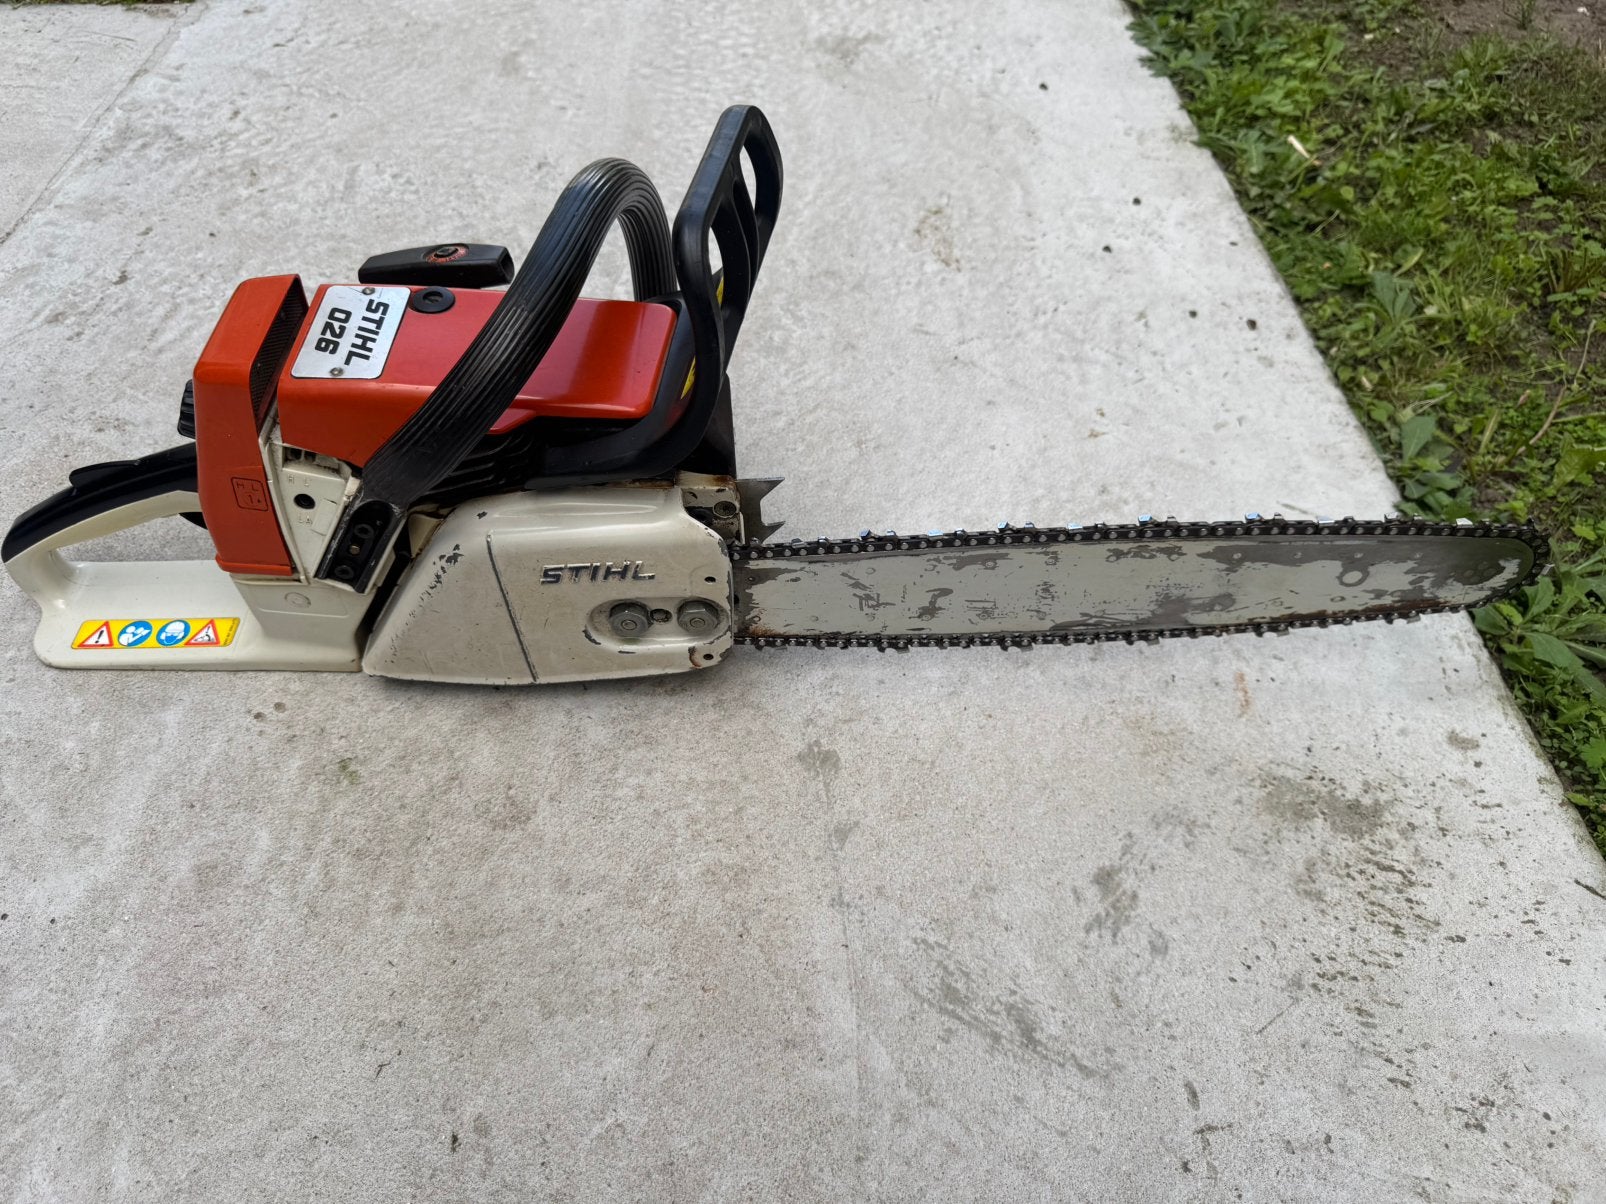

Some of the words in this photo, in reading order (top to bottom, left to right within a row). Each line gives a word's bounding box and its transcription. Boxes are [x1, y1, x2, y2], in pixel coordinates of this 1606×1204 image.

[314, 307, 353, 355] 026
[344, 298, 390, 366] STIHL
[540, 561, 656, 585] STIHL
